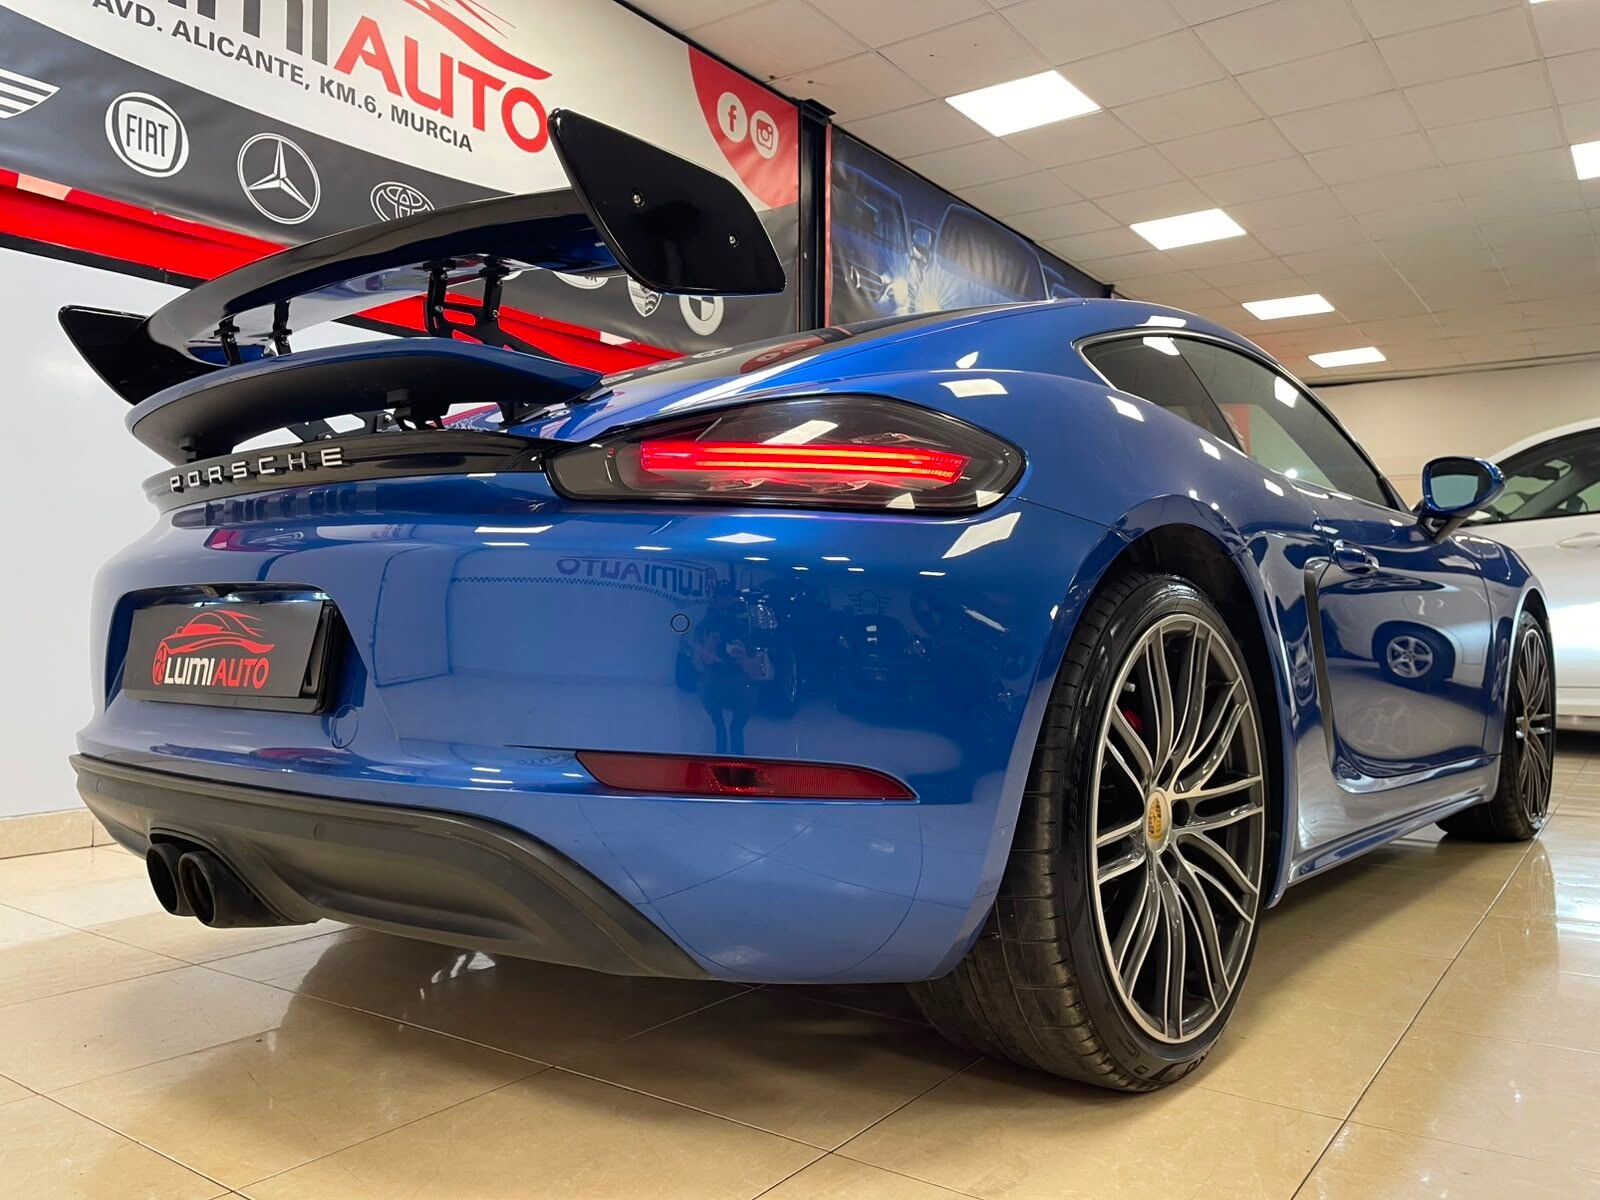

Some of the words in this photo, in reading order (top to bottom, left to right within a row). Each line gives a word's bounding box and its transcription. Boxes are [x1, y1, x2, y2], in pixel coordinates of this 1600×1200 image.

[92, 0, 163, 32] AVD.
[171, 19, 310, 90] ALICANTE,
[320, 76, 383, 119] KM.6,
[390, 104, 473, 152] MURCIA
[126, 113, 169, 157] FIAT
[169, 447, 344, 492] PORSCHE
[163, 656, 270, 689] LUMIAUTO
